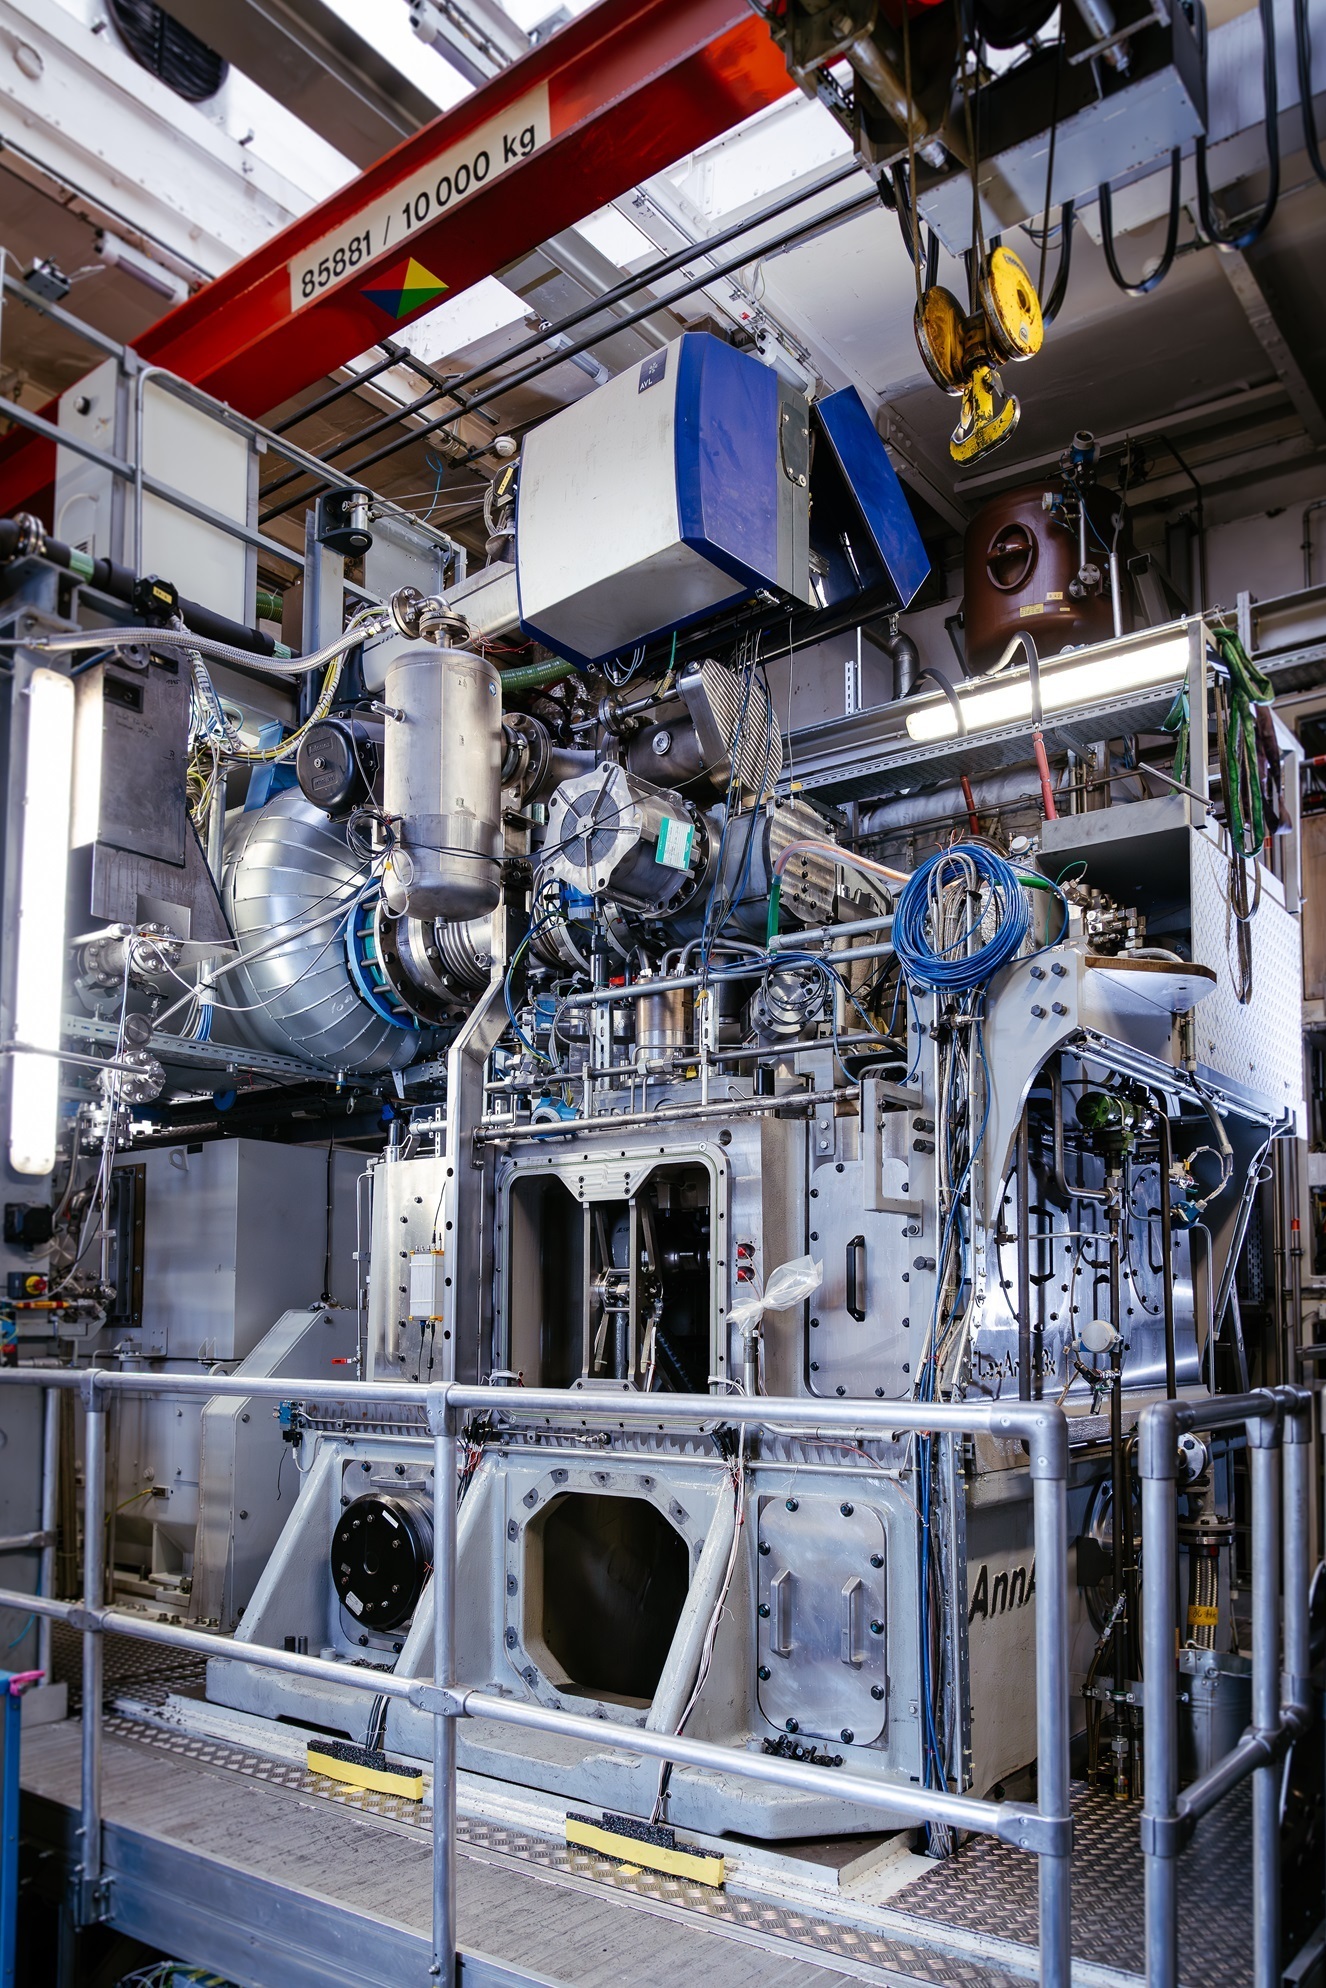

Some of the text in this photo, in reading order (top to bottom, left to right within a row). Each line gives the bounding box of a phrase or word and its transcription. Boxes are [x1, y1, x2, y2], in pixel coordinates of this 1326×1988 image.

[301, 229, 372, 299] 85881
[503, 124, 536, 164] kg
[639, 377, 653, 391] AVL
